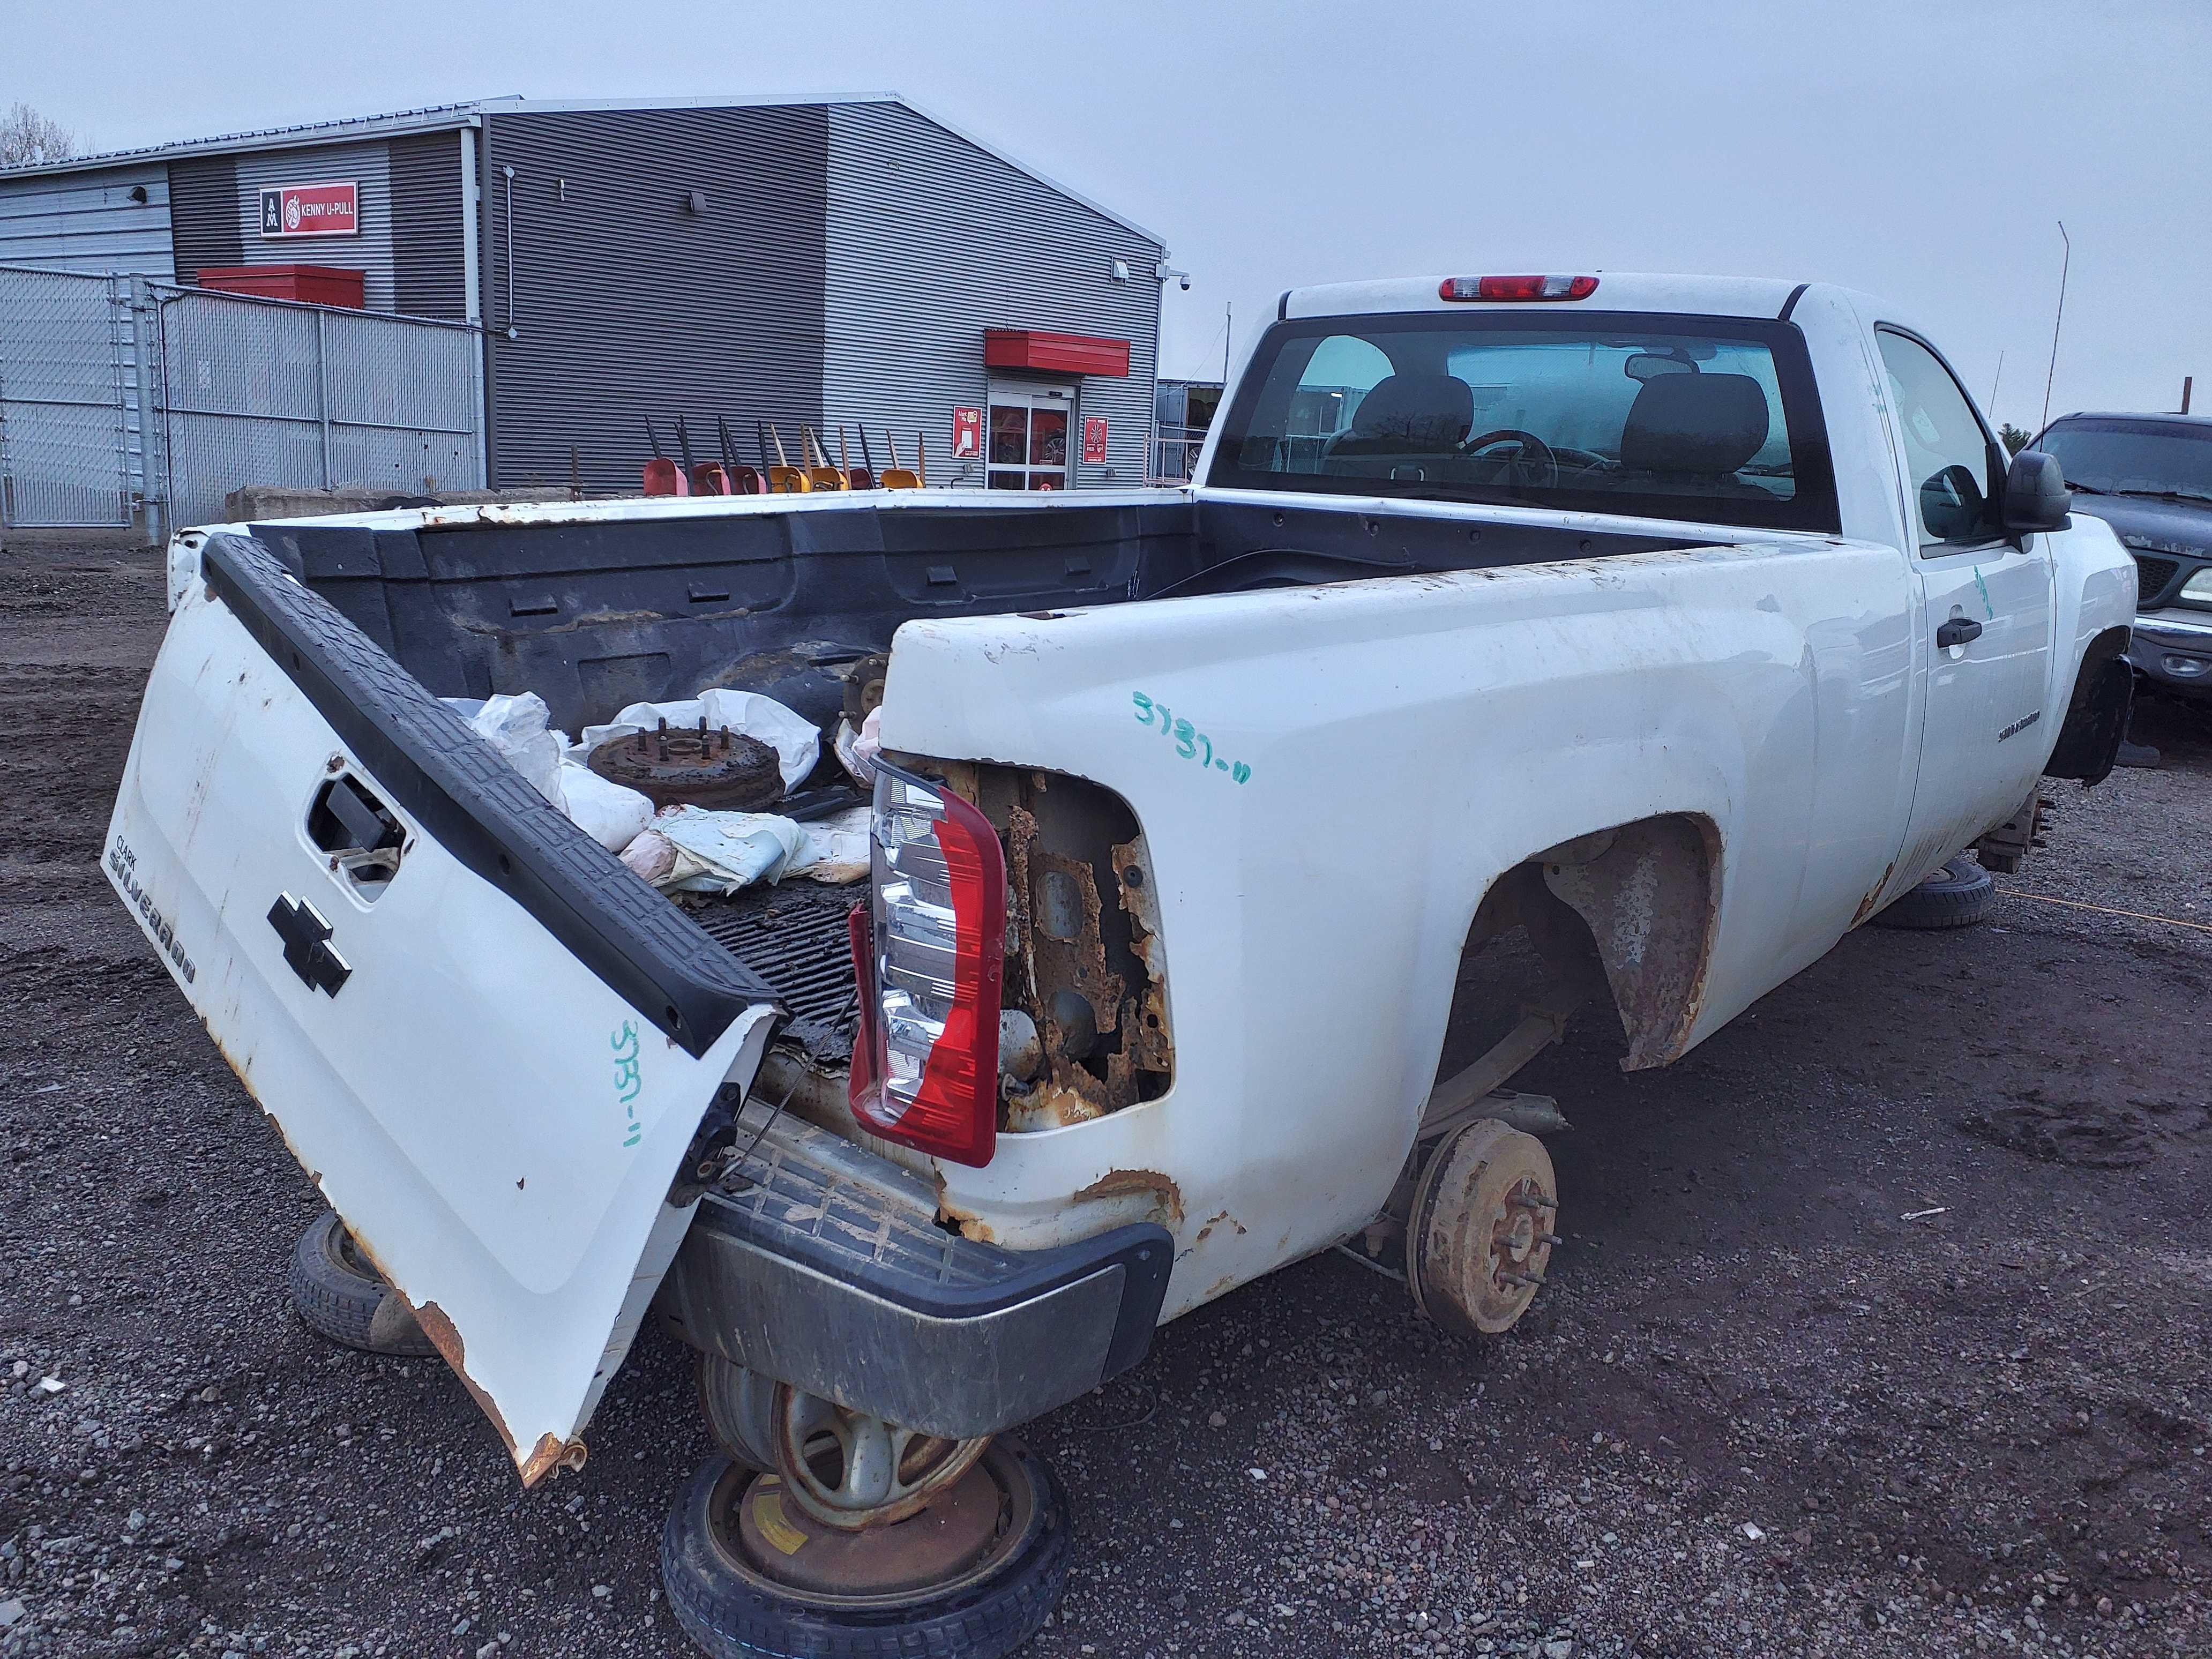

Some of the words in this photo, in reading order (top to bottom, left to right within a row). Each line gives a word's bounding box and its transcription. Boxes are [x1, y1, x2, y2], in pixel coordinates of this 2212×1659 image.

[301, 203, 324, 216] KENNY
[326, 201, 353, 215] U-PULL
[116, 834, 137, 872] CLARK
[108, 848, 196, 984] SILVERADO
